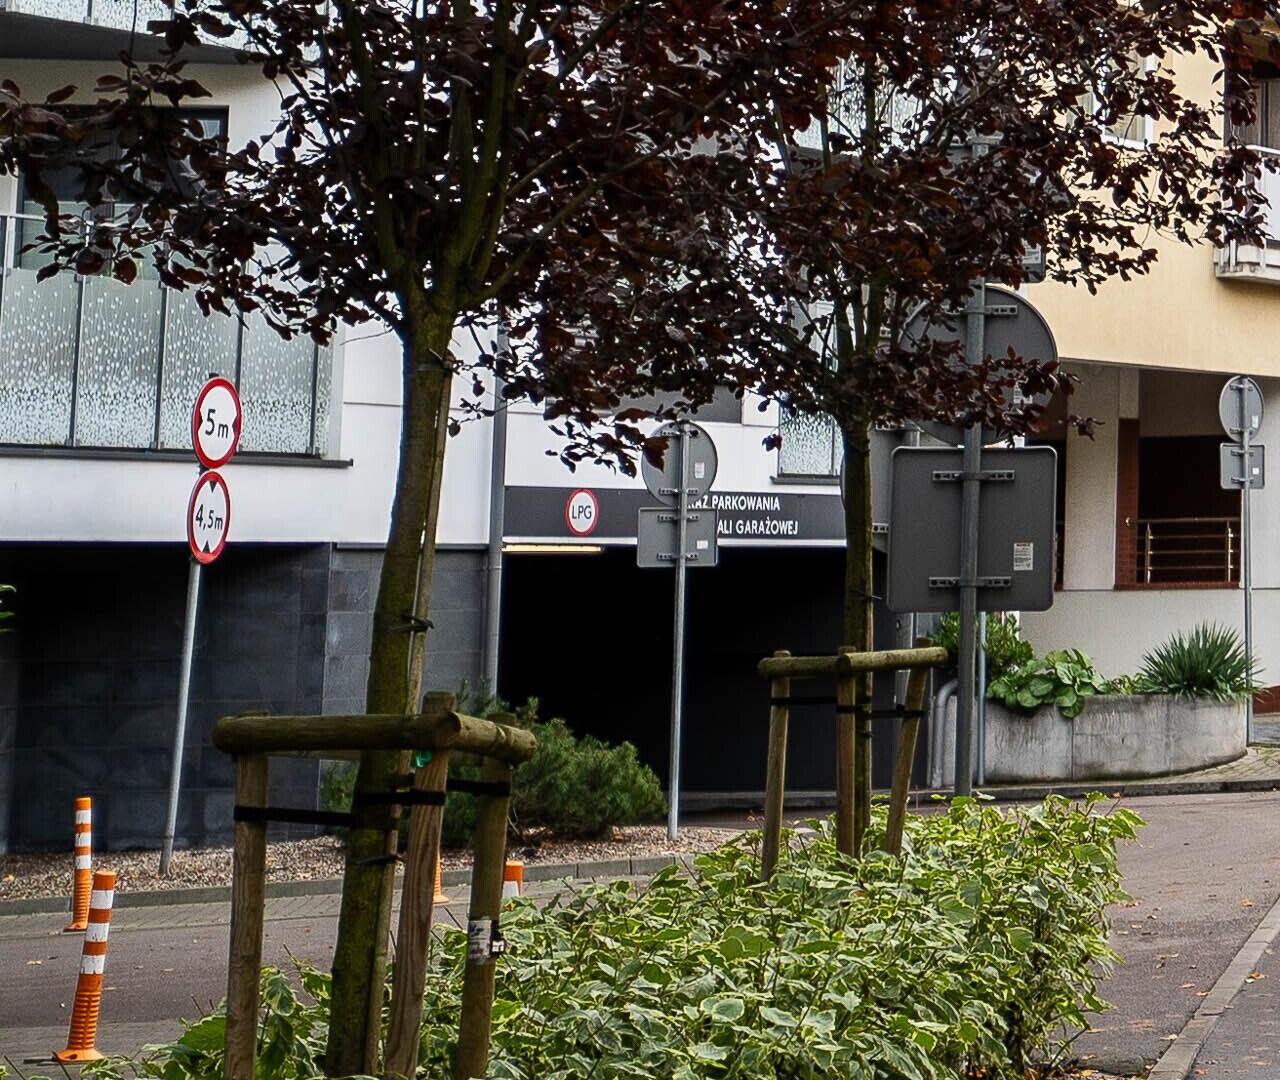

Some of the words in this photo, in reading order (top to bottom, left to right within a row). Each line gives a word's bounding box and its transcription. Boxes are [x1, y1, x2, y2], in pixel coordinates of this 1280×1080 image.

[711, 495, 781, 511] PARKOWANIA
[571, 504, 592, 520] LPG
[735, 516, 799, 536] GARAŻOWEJ
